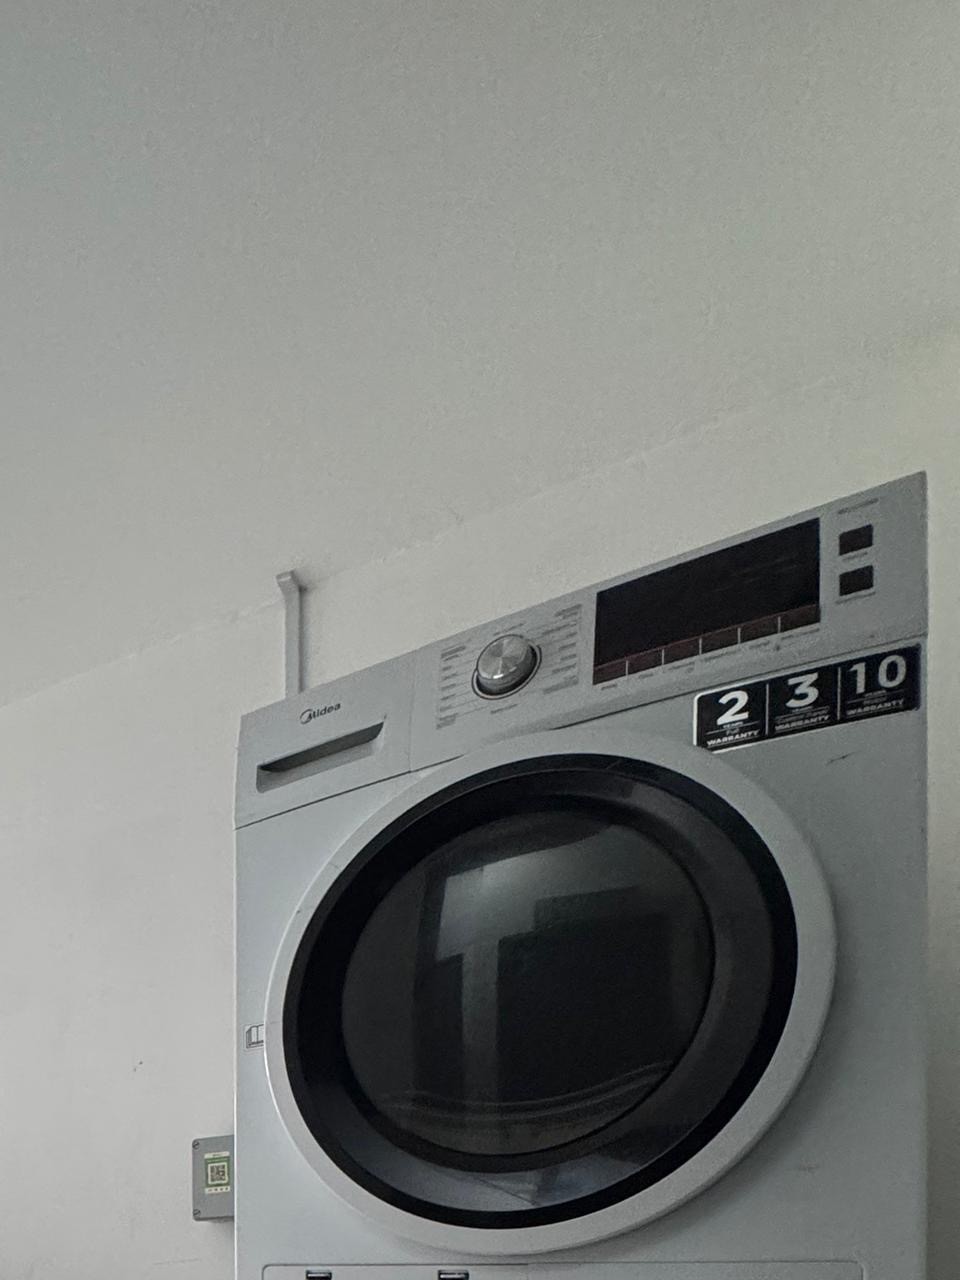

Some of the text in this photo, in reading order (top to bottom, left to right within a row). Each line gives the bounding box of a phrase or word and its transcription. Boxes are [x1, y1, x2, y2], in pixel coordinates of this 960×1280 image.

[785, 672, 819, 708] 3
[848, 654, 907, 694] 10
[717, 690, 750, 726] 2
[707, 730, 759, 746] WARRANTY
